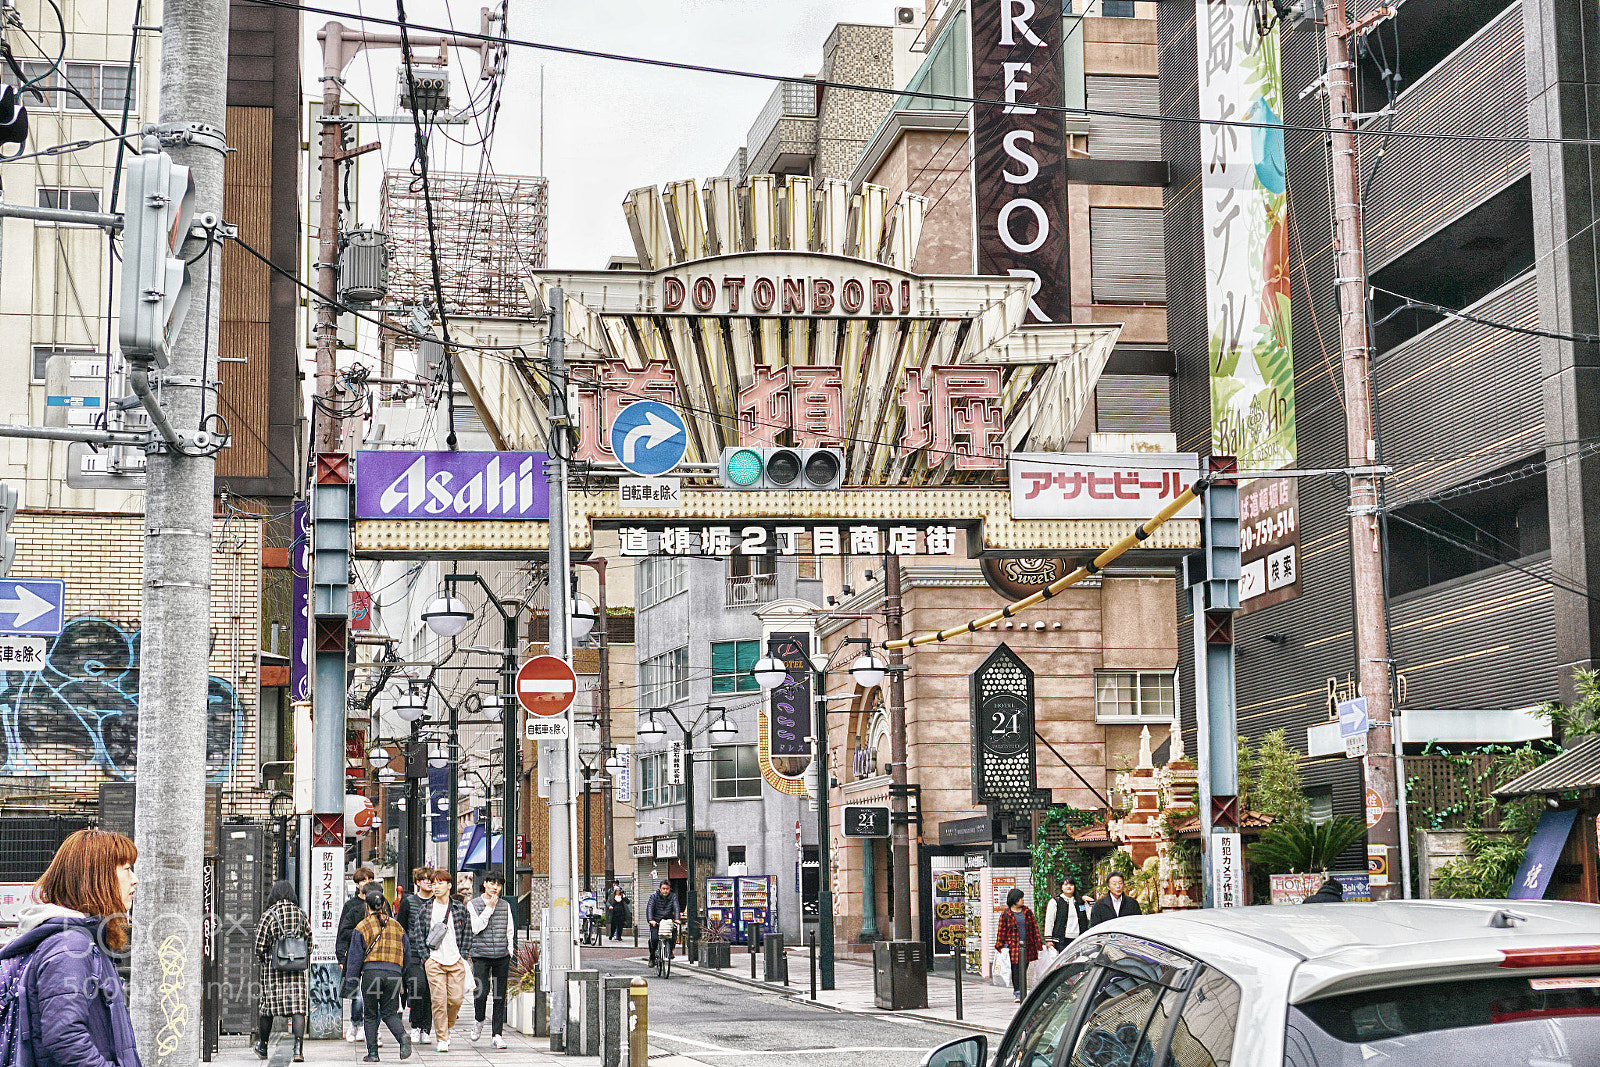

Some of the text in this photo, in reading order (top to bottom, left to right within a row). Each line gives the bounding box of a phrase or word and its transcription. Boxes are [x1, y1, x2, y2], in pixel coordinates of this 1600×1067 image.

[664, 276, 911, 313] DOTONBORI
[1219, 409, 1246, 457] Bali
[380, 454, 534, 514] Asahi
[621, 484, 678, 501] 自転車を除く
[1021, 471, 1190, 500] アサヒビール
[618, 526, 957, 556] 道頓堀2丁目商店街
[1240, 507, 1295, 553] 20-759-514
[1006, 562, 1056, 585] Sweets
[0, 645, 42, 663] 車を除く
[784, 660, 804, 669] OTEL
[527, 723, 566, 735] 自転車を除く
[991, 711, 1021, 734] 24
[858, 812, 876, 827] 24
[1221, 837, 1233, 908] 防犯カメラ作動中
[322, 851, 333, 931] 防犯カメラ作動中
